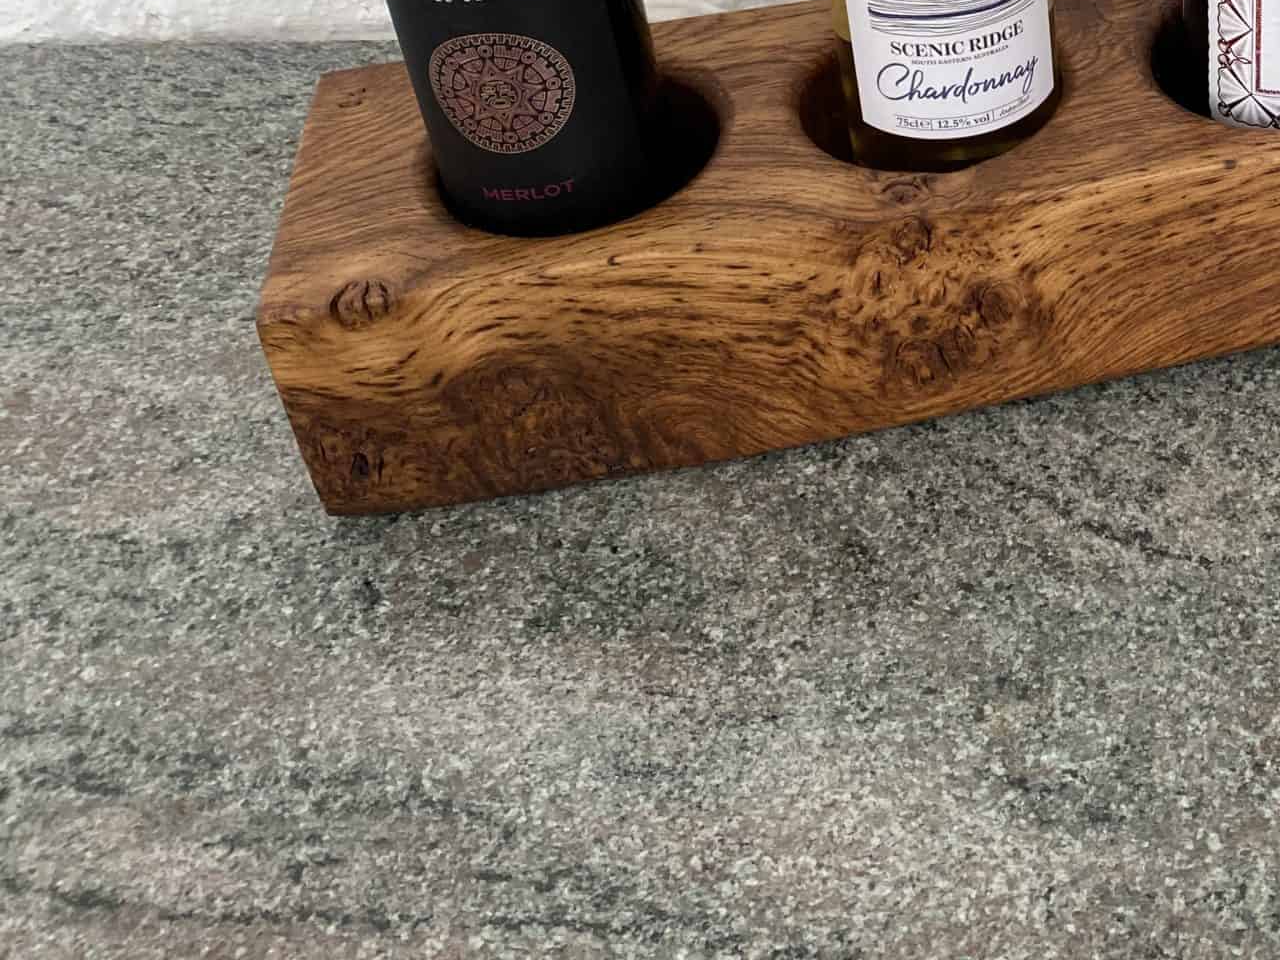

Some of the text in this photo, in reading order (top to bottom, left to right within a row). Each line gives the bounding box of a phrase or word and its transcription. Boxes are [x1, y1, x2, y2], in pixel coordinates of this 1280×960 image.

[890, 19, 1025, 58] SCENIC RIDGE
[876, 55, 1039, 104] Chardonnay
[938, 116, 972, 129] 12.5%
[974, 113, 991, 124] vol
[482, 179, 576, 201] MERLOT
